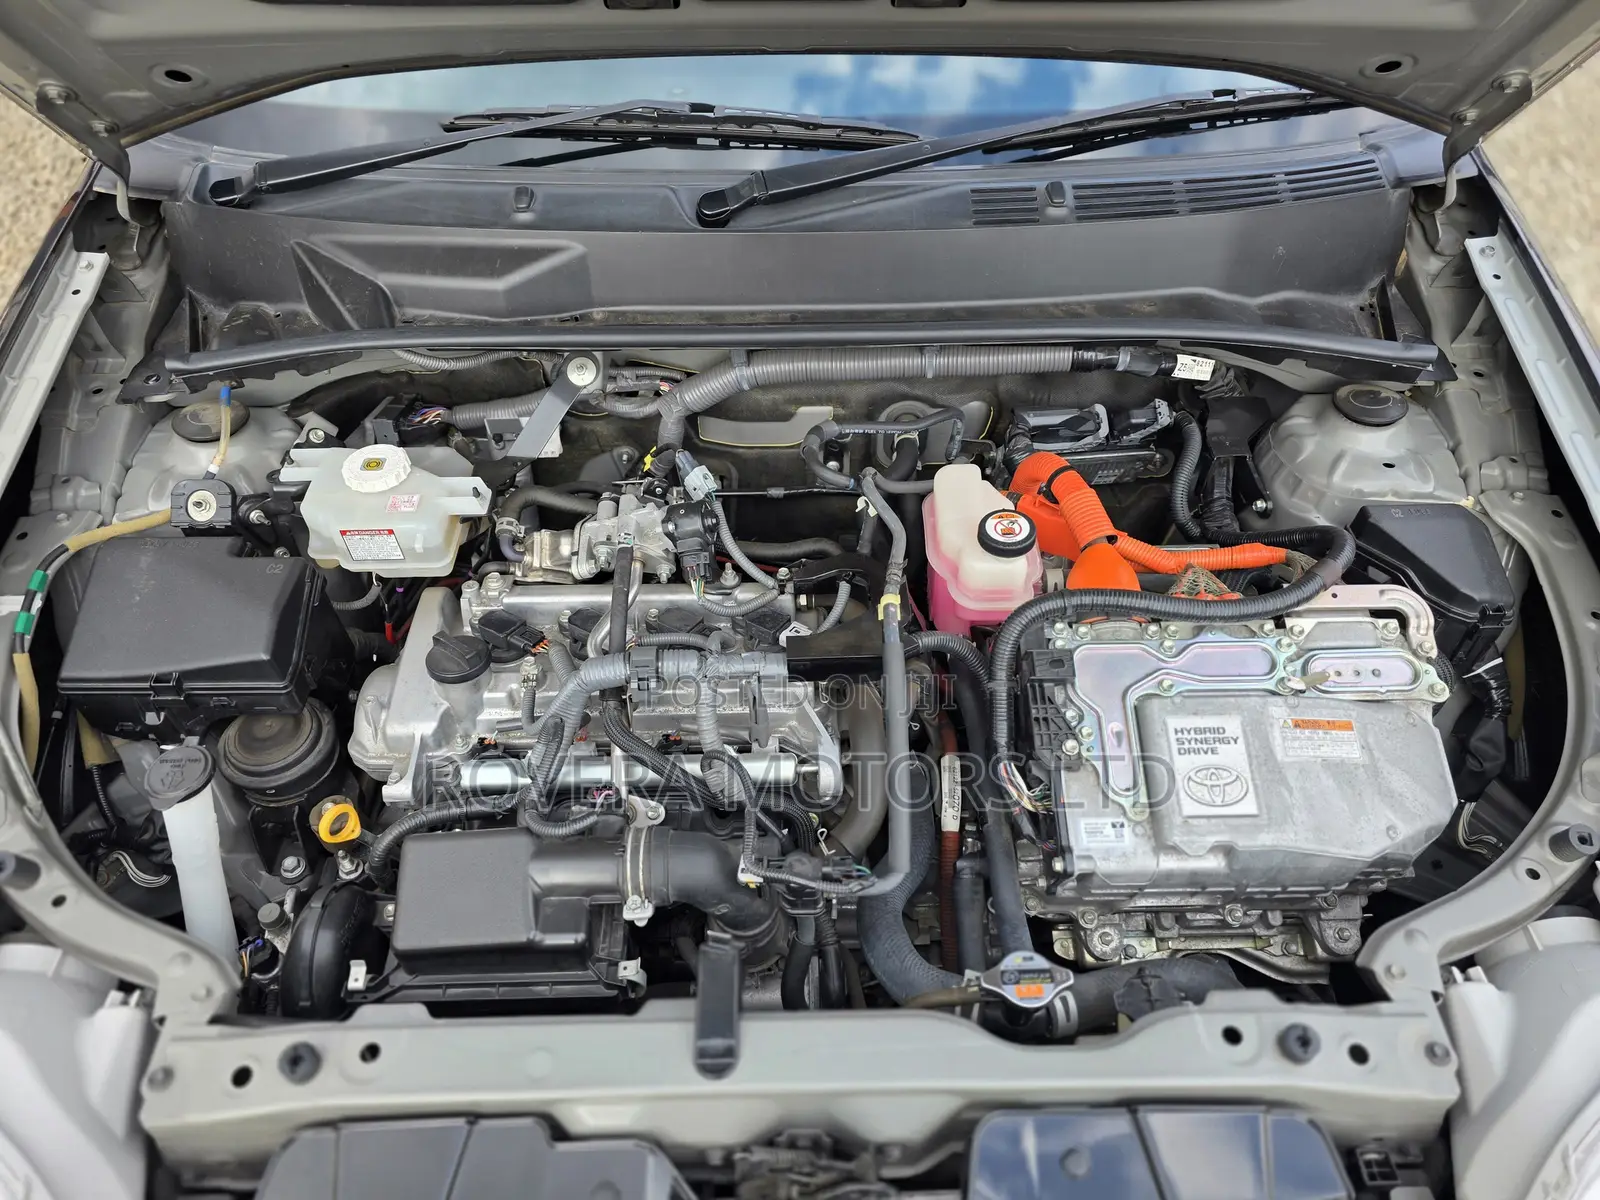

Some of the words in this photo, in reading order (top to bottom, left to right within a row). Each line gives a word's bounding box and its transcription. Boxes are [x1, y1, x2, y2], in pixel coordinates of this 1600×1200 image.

[266, 563, 284, 574] C2
[1174, 726, 1226, 736] HYBRID
[1176, 736, 1239, 746] SYNERGY
[1178, 746, 1220, 756] DRIVE
